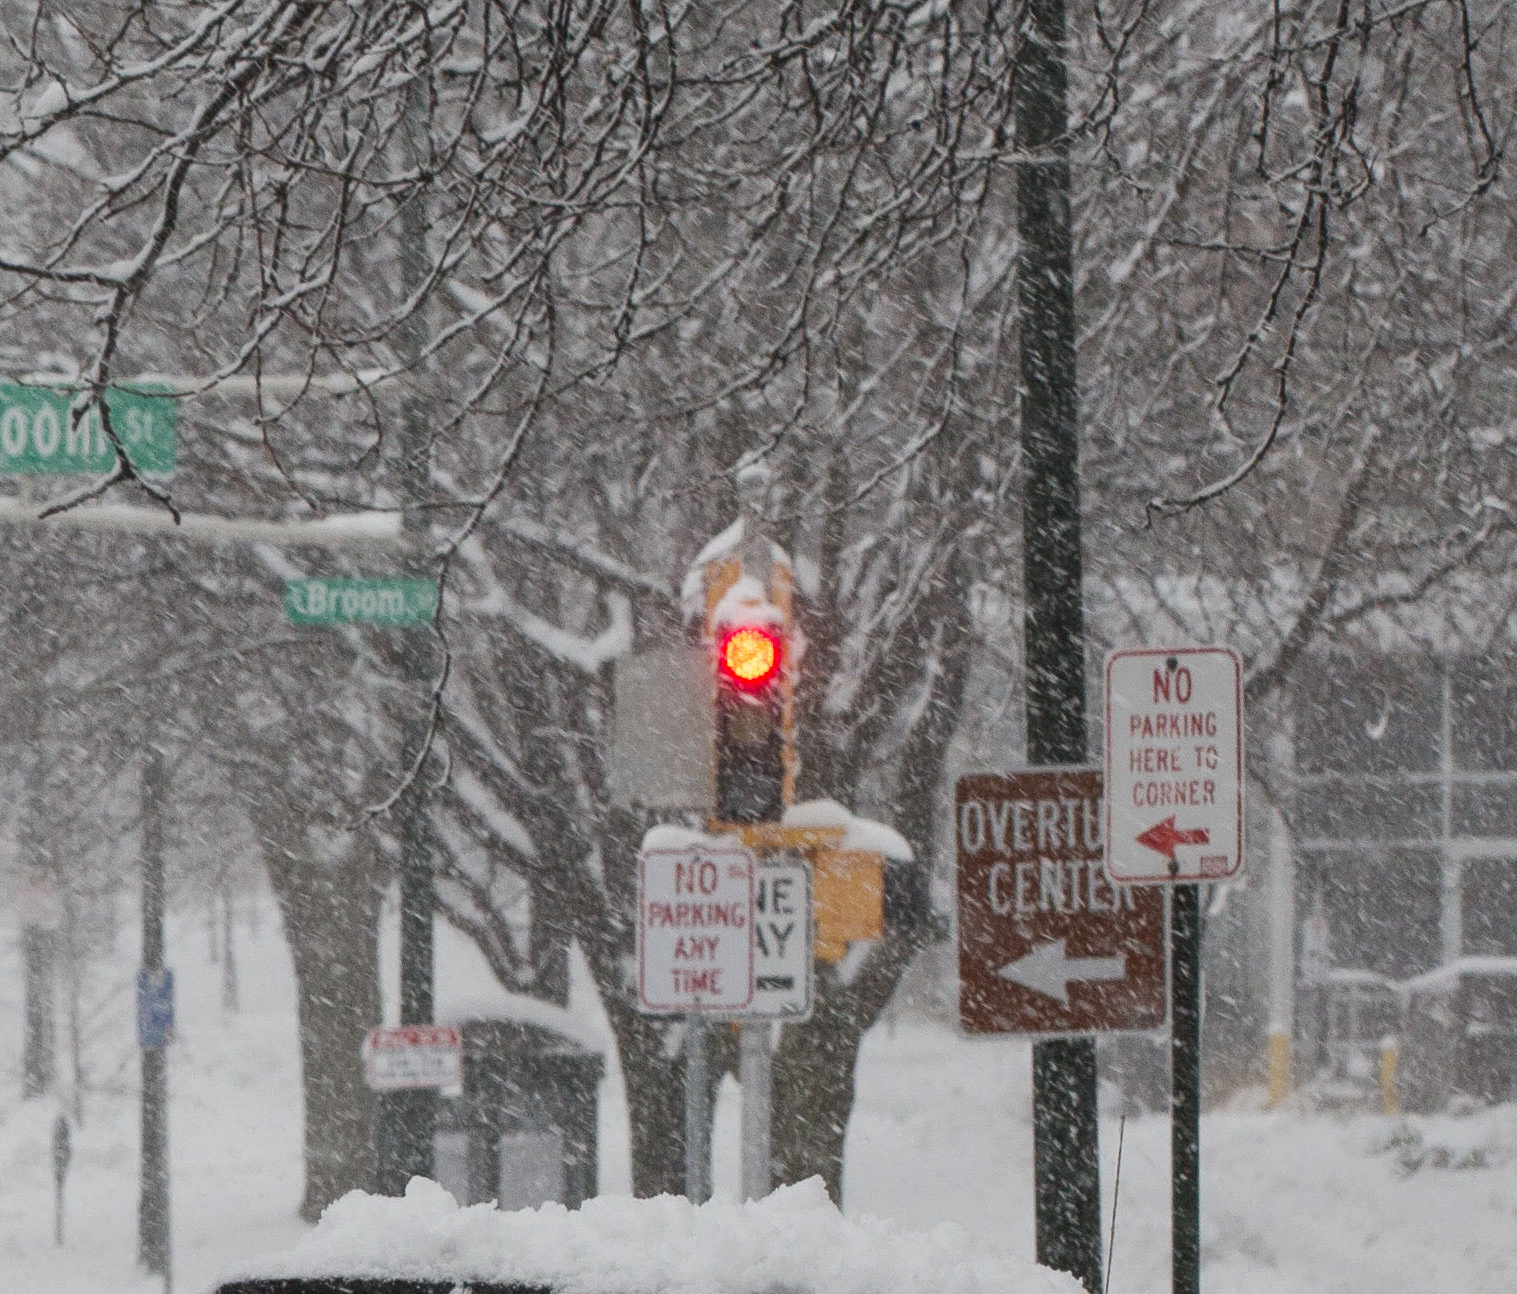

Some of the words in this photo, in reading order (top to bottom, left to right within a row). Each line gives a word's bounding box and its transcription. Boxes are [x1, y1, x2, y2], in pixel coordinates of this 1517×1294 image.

[307, 577, 405, 616] Broom
[1152, 667, 1192, 704] NO
[1129, 712, 1217, 738] PARKING
[1129, 746, 1182, 773] HERE
[1195, 745, 1218, 770] TO
[1132, 778, 1216, 807] CORNER
[960, 798, 1103, 853] OVERTU
[674, 861, 718, 896] NO
[648, 902, 746, 928] PARKING
[674, 936, 720, 960] ANY
[671, 967, 723, 995] TIME
